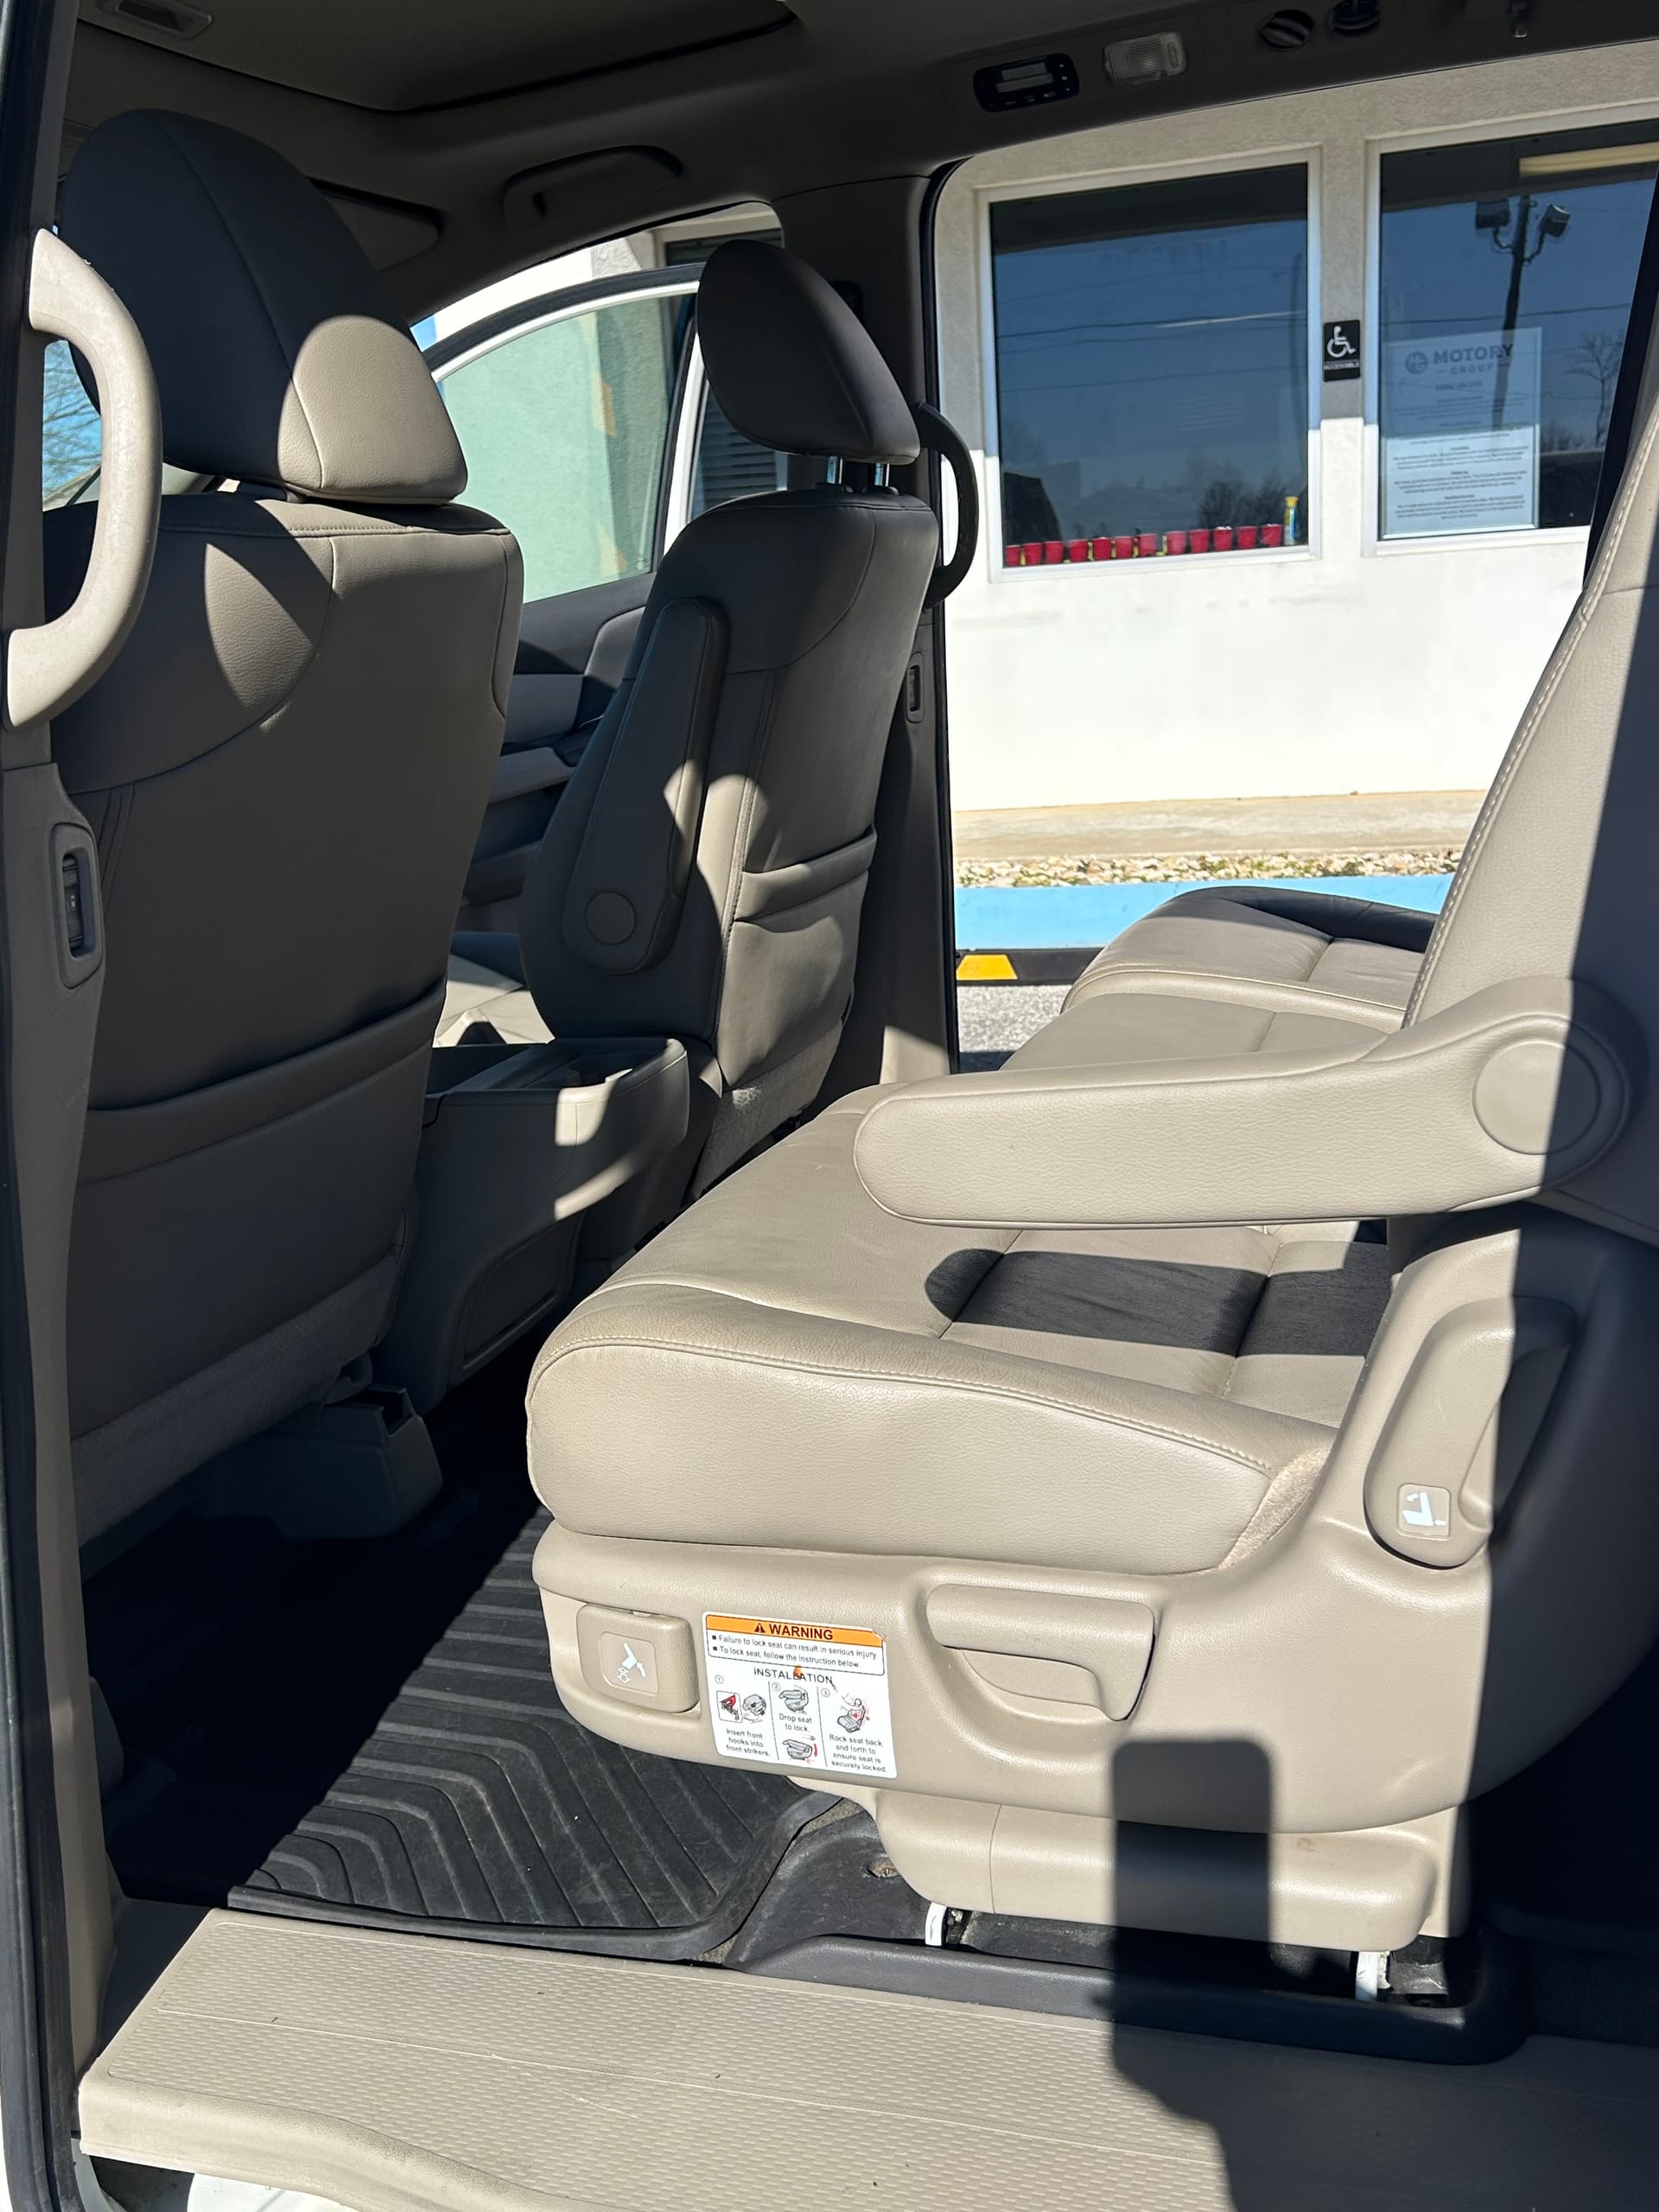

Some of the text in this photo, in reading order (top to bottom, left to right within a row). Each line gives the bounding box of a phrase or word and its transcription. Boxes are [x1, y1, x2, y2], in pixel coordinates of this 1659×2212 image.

[1433, 344, 1514, 365] MOTORY
[768, 1624, 834, 1640] WARNING
[718, 1634, 742, 1645] Failure
[752, 1638, 766, 1647] lock
[798, 1644, 818, 1653] result
[828, 1646, 855, 1656] serious
[719, 1645, 728, 1654] To
[729, 1647, 744, 1656] lock
[746, 1649, 761, 1658] seat,
[763, 1651, 785, 1660] follow
[798, 1654, 836, 1665] instruction
[779, 1713, 812, 1725] Drop seat
[726, 1728, 763, 1739] Insert front
[728, 1737, 764, 1748] hooks into
[830, 1733, 883, 1747] Rock seat back
[850, 1745, 868, 1754] forth
[833, 1752, 882, 1764] ensure seat is
[830, 1760, 861, 1770] securely
